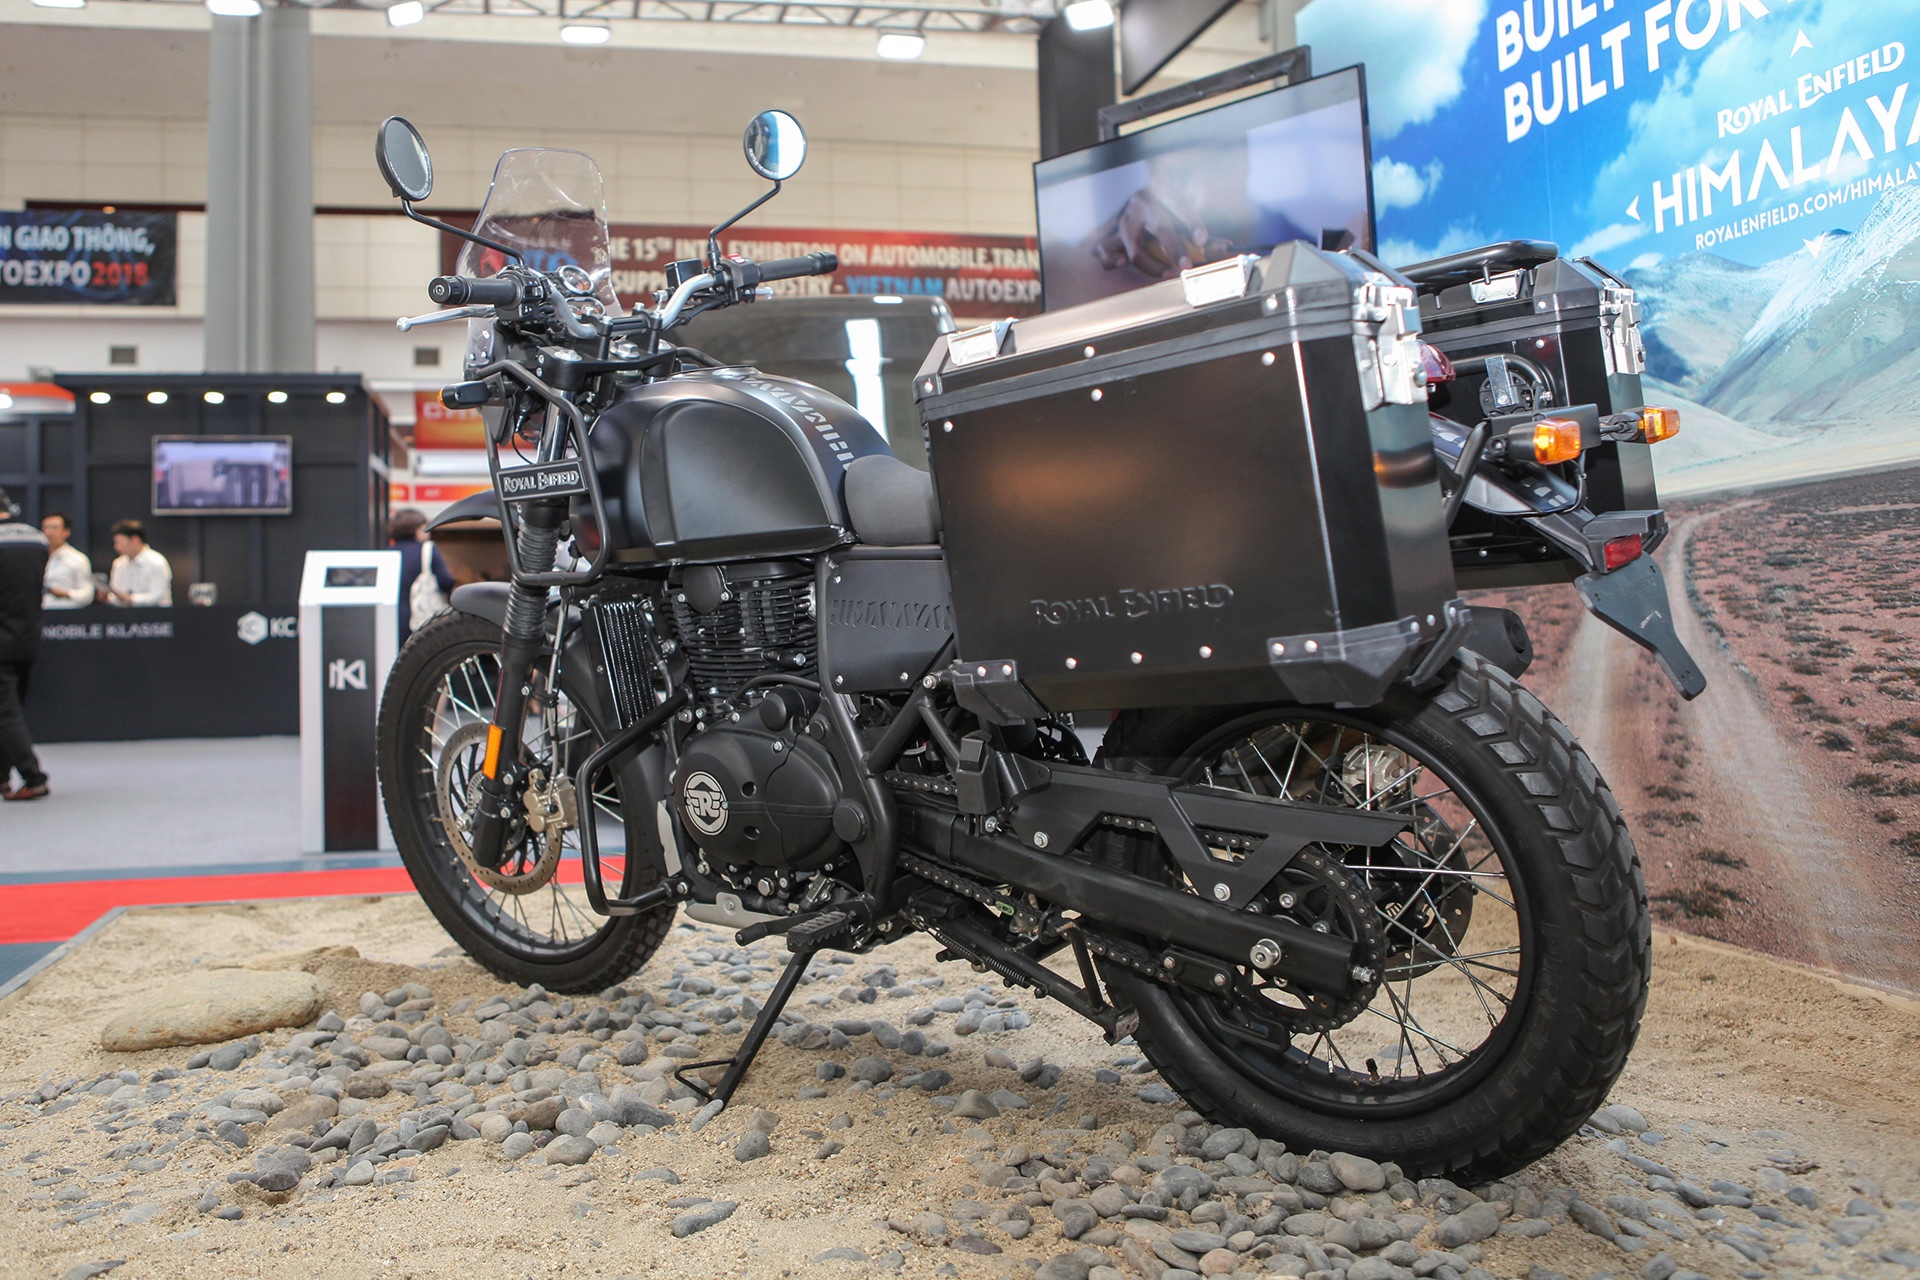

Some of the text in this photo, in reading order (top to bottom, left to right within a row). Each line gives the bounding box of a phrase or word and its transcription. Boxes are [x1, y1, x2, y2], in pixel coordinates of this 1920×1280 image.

[1496, 0, 1615, 73] BUIL
[1504, 20, 1631, 144] BUILT
[1717, 41, 1906, 139] ROYAL ENFIELD
[1652, 82, 1920, 234] HIMALAY
[14, 225, 70, 251] GIAO
[840, 243, 867, 266] ON
[845, 275, 943, 297] VIETNAM
[502, 470, 580, 494] ROYAL ENFIELD
[1029, 583, 1236, 628] ROYAL ENFIELD
[105, 621, 175, 639] KLASSE
